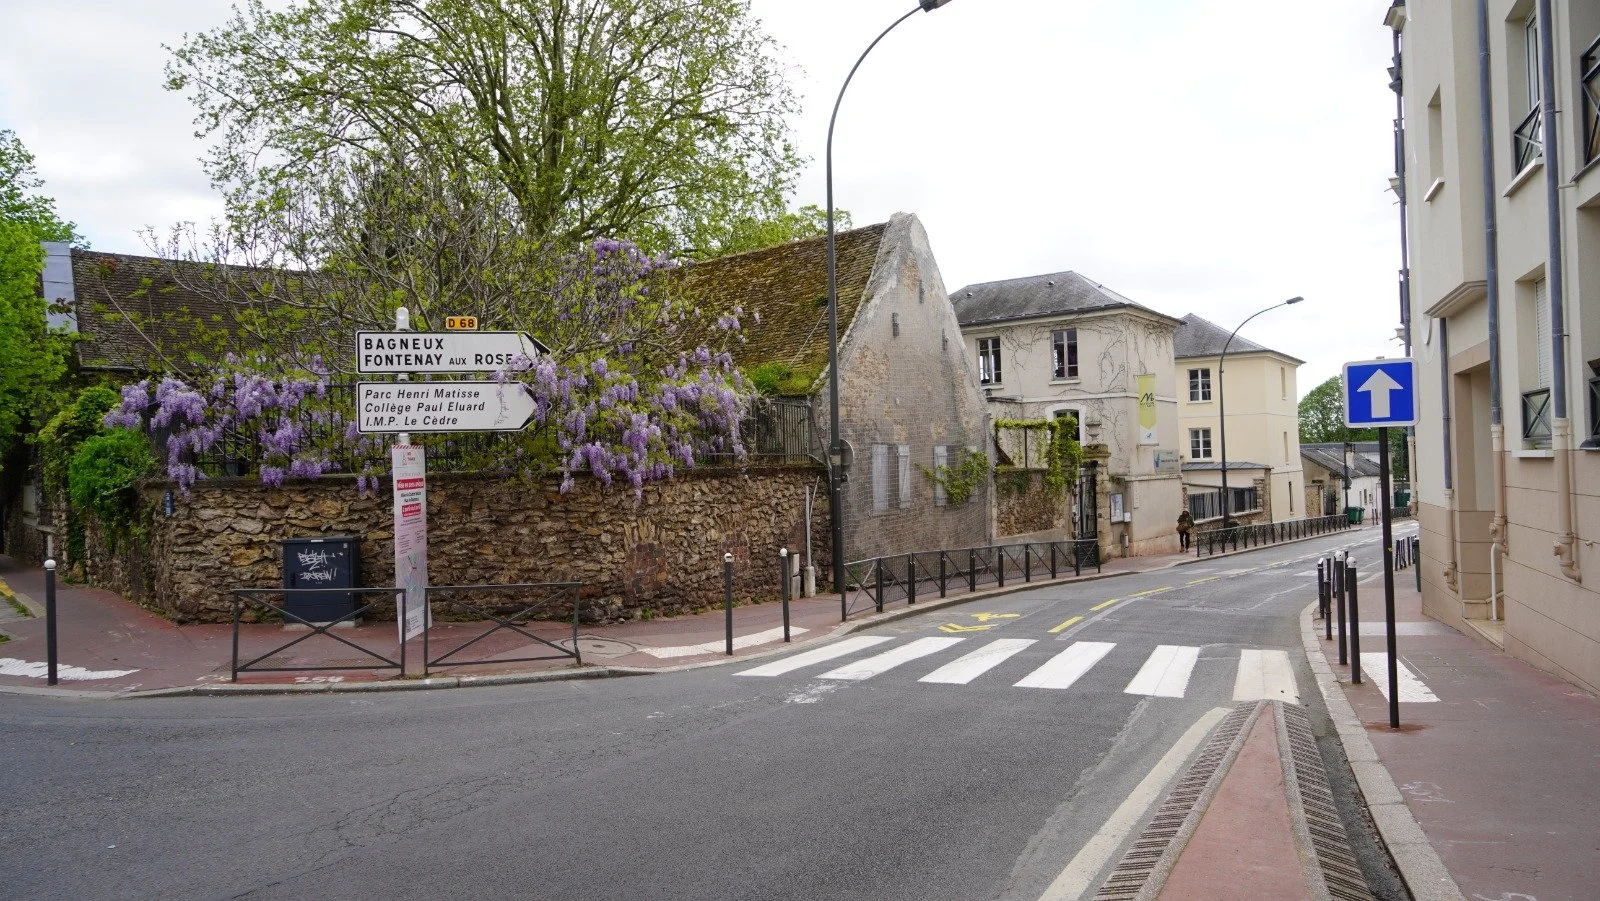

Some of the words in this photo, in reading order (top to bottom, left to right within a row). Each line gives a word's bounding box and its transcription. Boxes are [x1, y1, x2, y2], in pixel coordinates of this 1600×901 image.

[448, 319, 455, 328] D
[460, 319, 475, 328] 68
[364, 338, 444, 350] BAGNEUX
[364, 354, 443, 366] FONTENAY
[449, 357, 467, 365] AUX
[474, 353, 514, 365] ROSE
[365, 389, 392, 399] Parc
[397, 389, 430, 399] Henri
[434, 388, 480, 398] Matisse
[365, 402, 411, 415] Collège
[416, 402, 443, 412] Paul
[447, 401, 486, 412] Eluard
[365, 416, 399, 426] I.M.P.
[404, 416, 418, 426] Le
[423, 415, 458, 425] Cèdre
